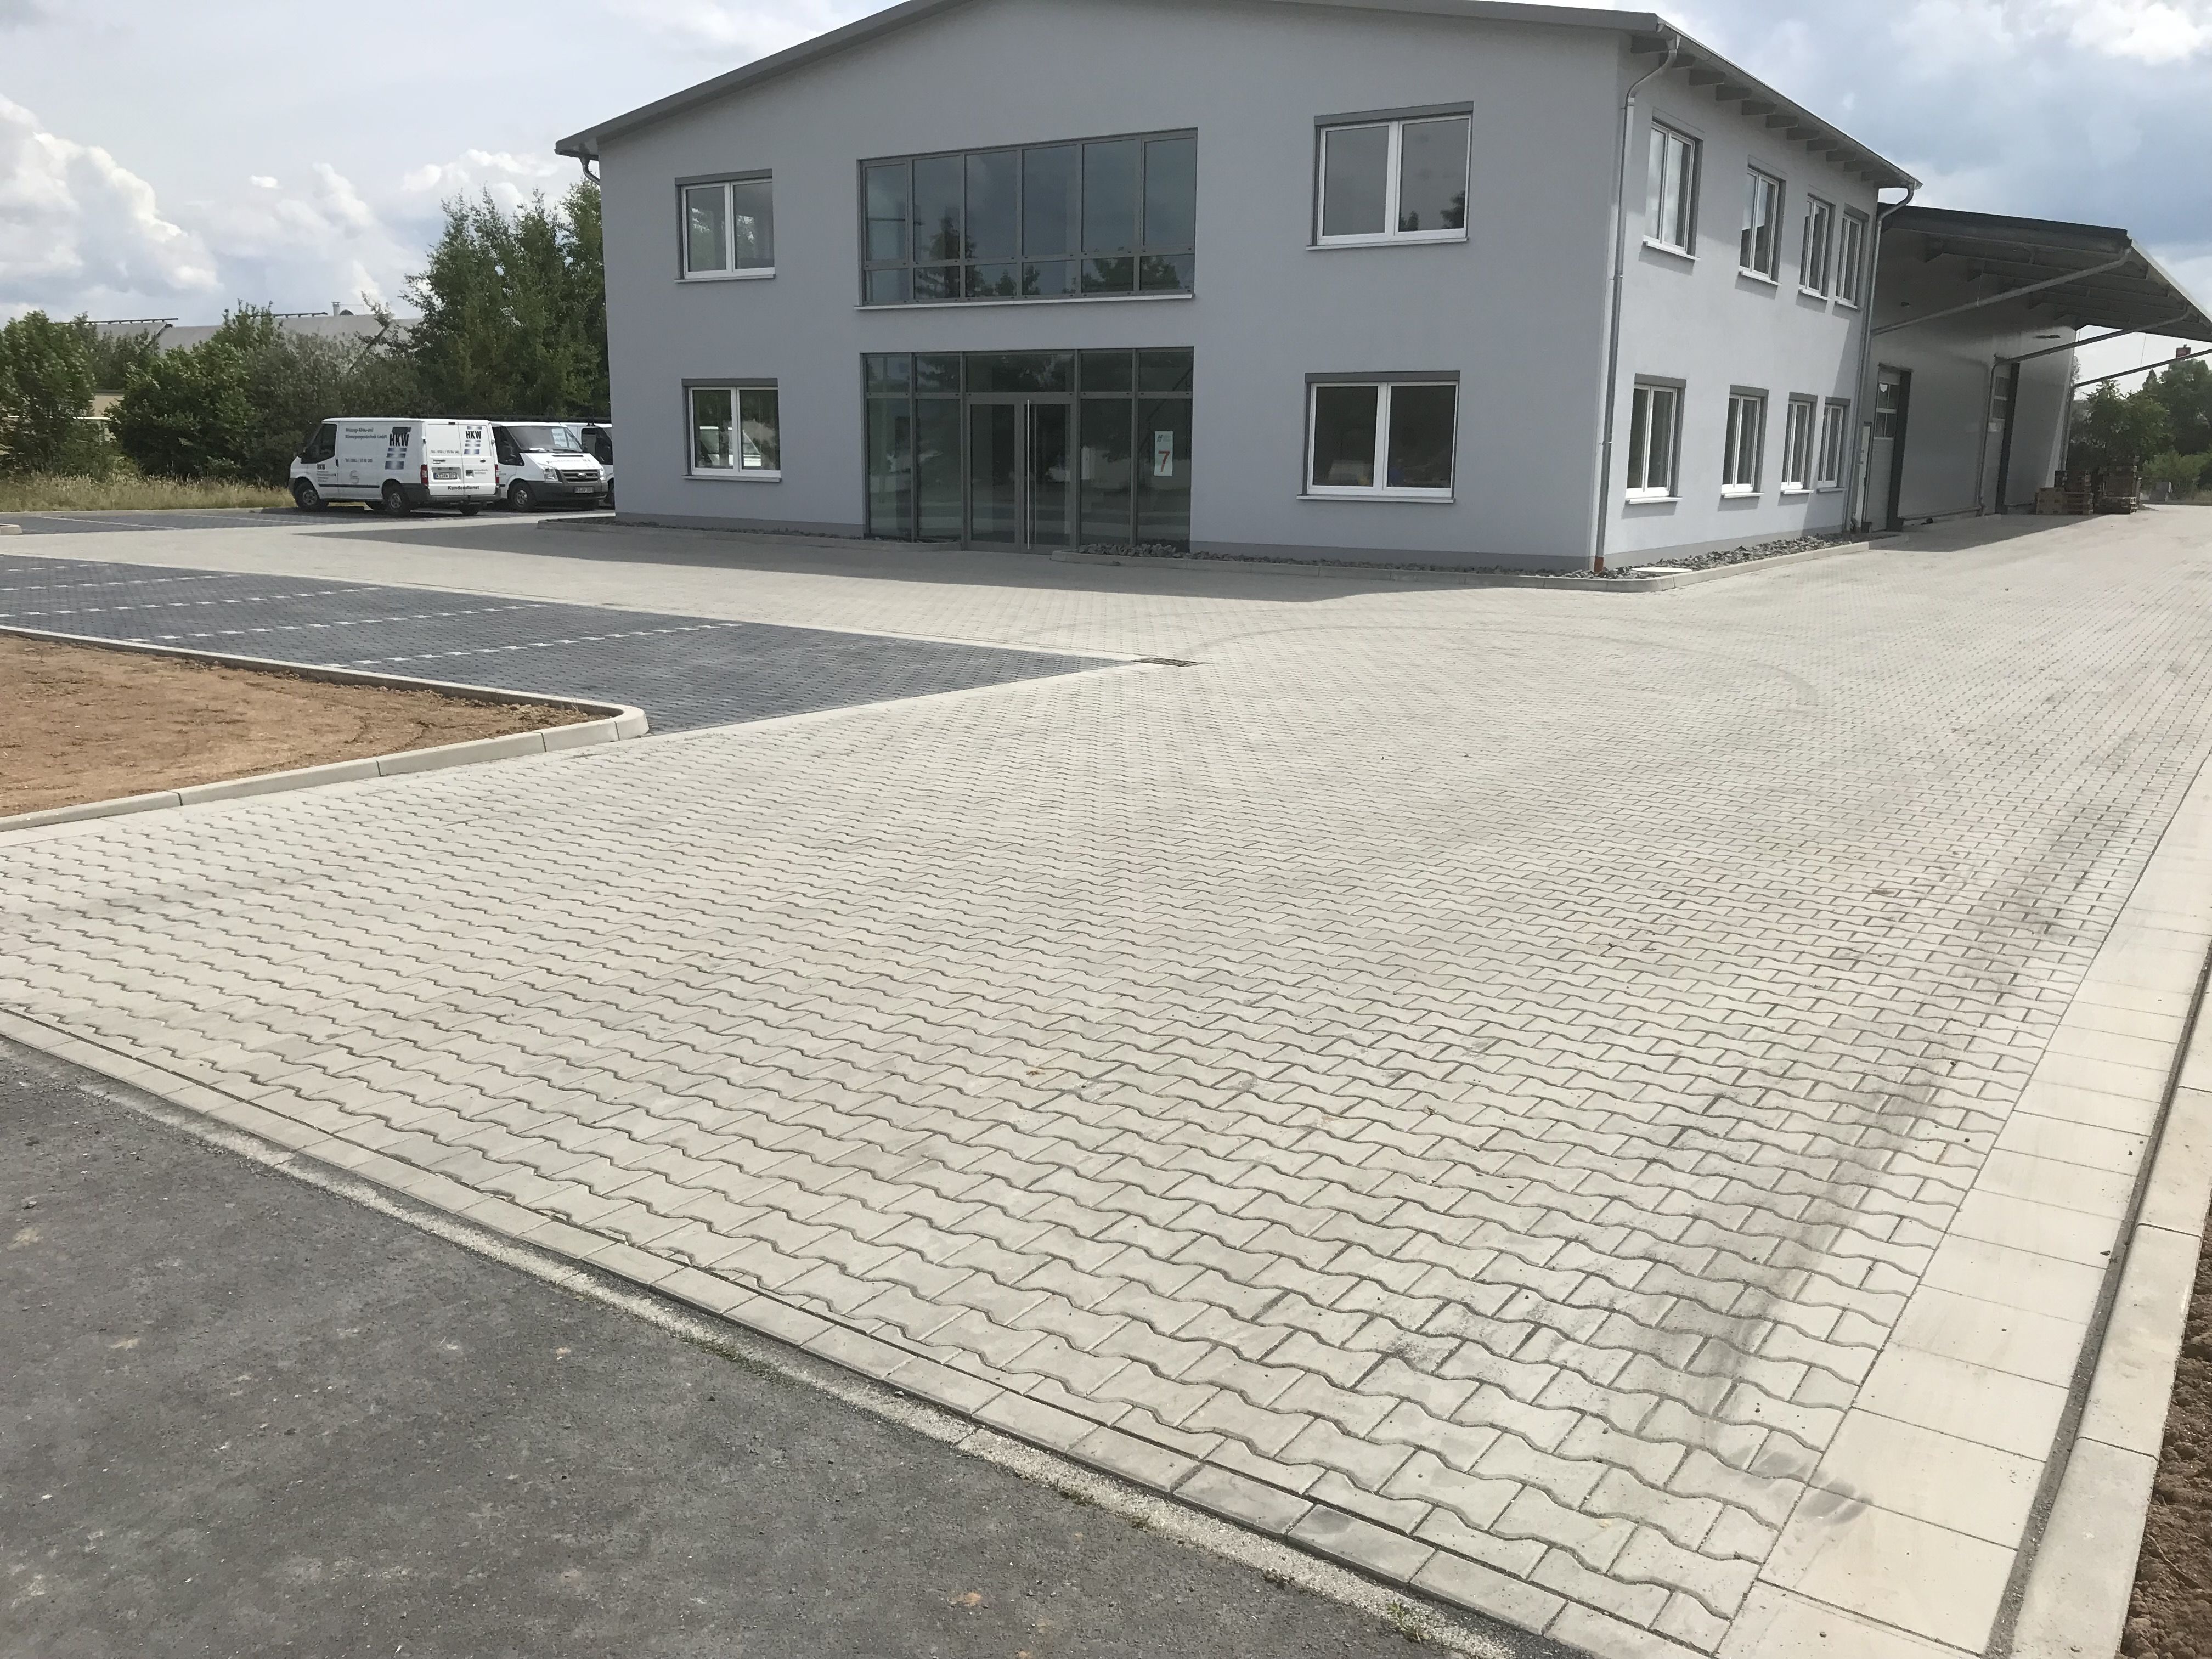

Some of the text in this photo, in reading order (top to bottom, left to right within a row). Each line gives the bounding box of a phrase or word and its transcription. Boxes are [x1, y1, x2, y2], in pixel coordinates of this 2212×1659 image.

[390, 434, 409, 446] HKW
[465, 431, 481, 439] HKW
[1158, 451, 1170, 472] 7
